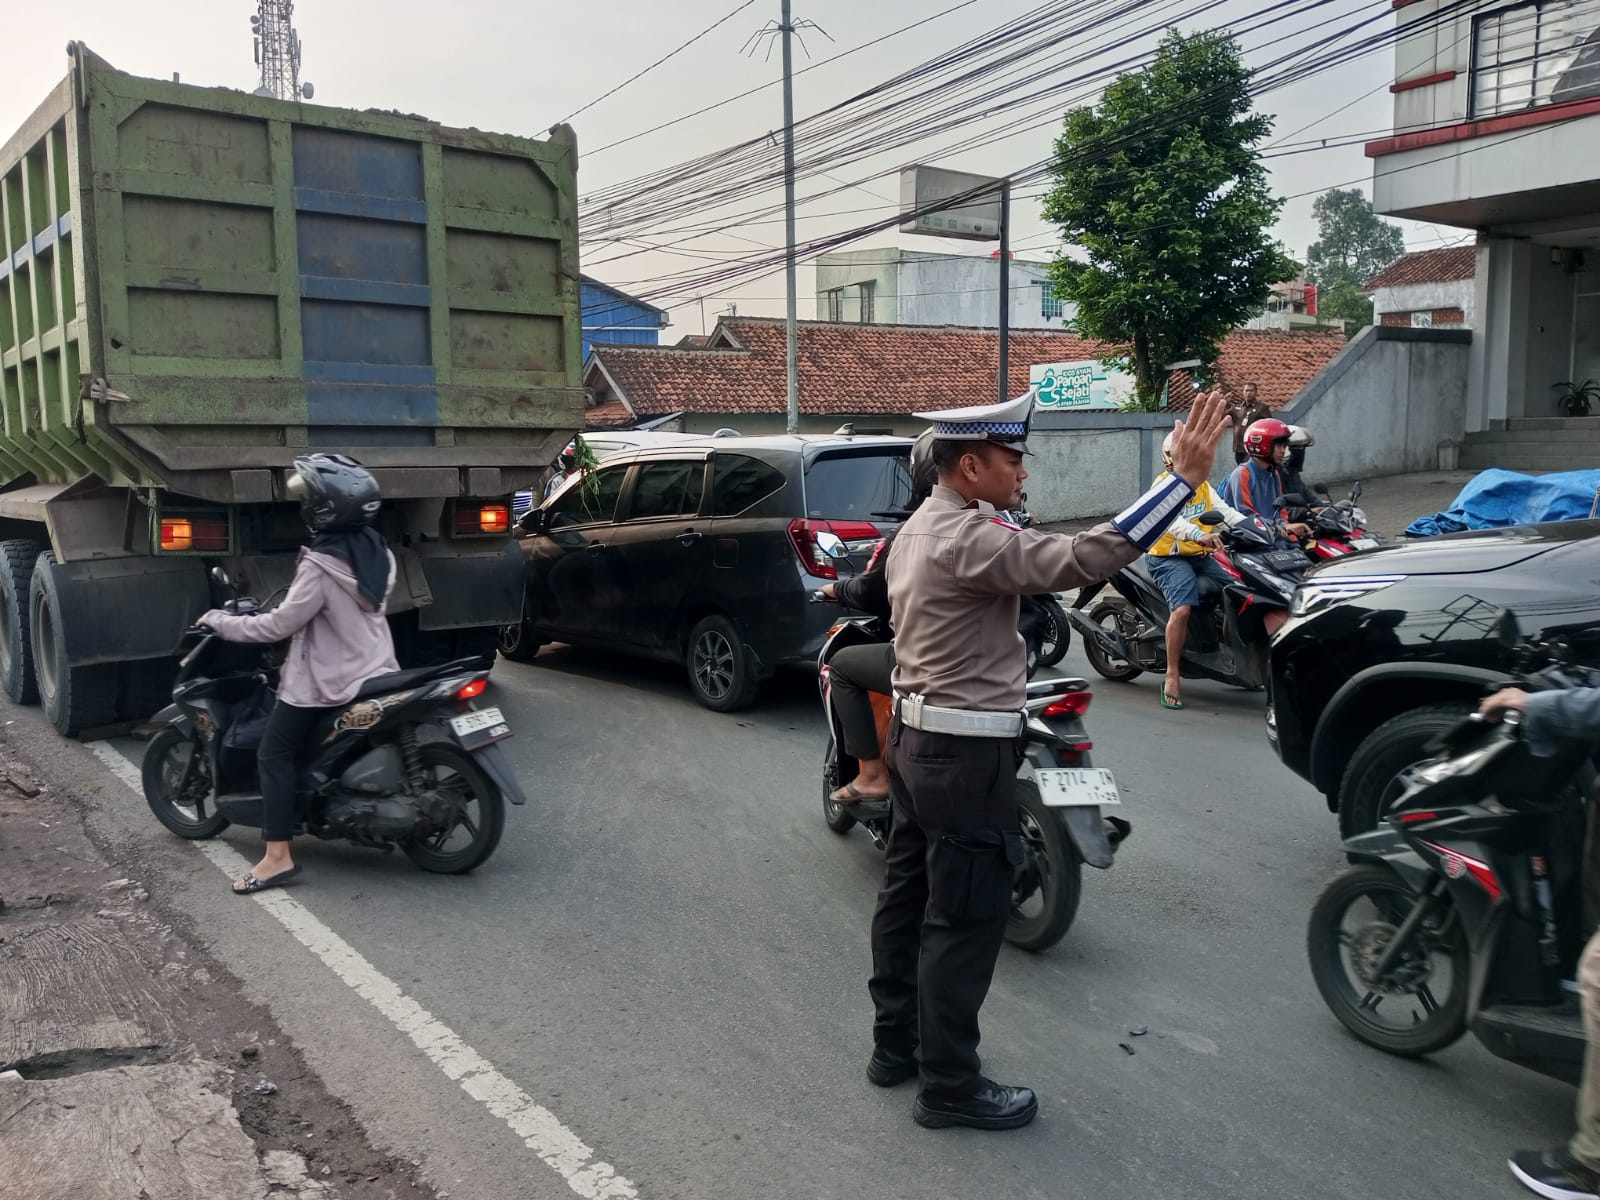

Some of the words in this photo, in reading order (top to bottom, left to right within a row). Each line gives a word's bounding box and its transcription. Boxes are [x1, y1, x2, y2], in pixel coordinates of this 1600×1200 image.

[1076, 367, 1091, 375] AYAM
[1057, 373, 1092, 388] Pangan
[1062, 383, 1089, 400] Sejati
[1040, 772, 1049, 788] F
